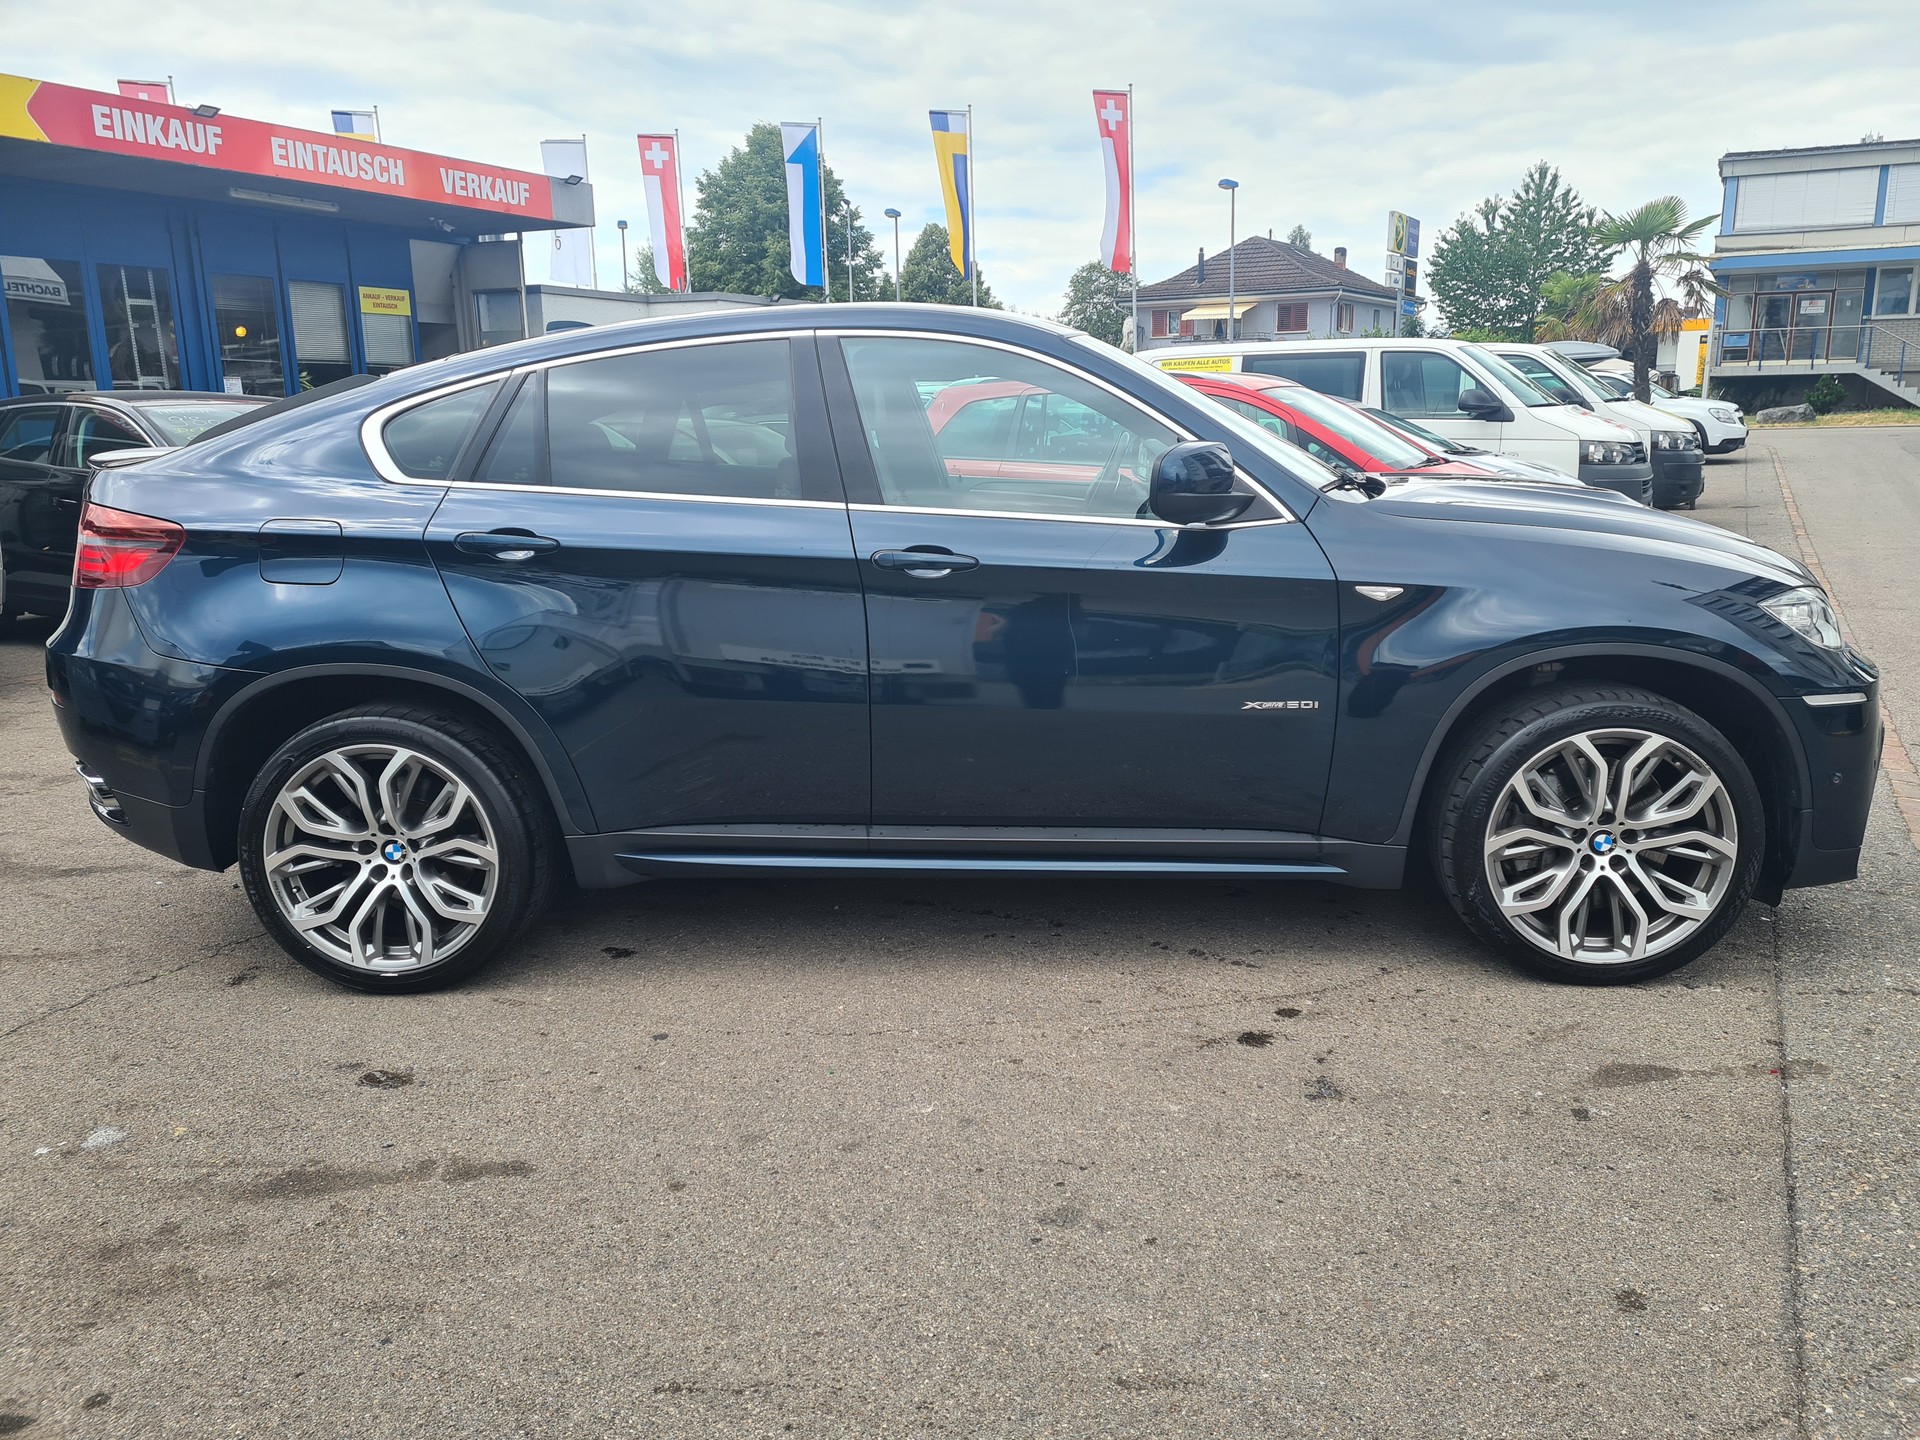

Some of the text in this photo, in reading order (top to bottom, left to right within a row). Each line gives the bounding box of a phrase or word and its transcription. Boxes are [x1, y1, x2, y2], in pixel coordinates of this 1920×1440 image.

[91, 104, 530, 206] EINKAUF EINTAUSCH VERKAUF
